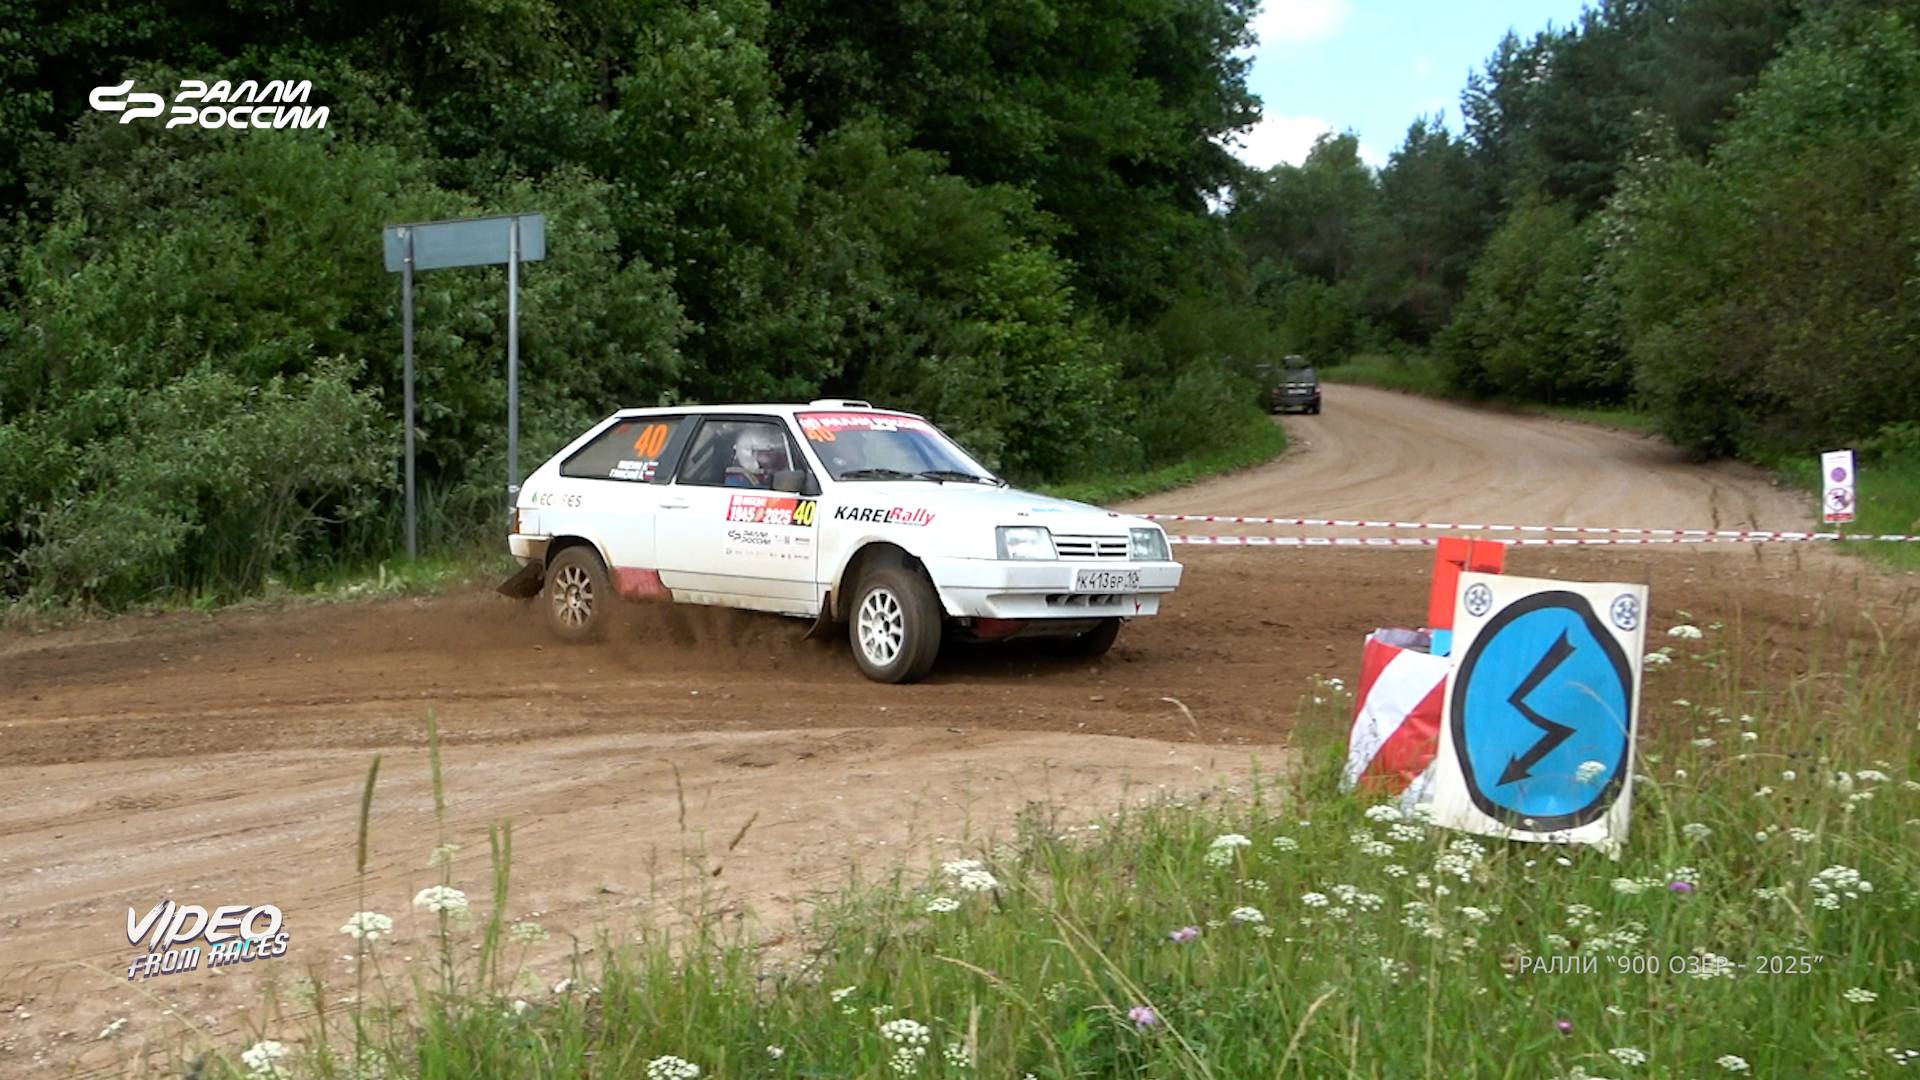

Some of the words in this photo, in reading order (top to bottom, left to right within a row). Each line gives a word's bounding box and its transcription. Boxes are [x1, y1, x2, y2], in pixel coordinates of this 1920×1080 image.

[634, 424, 668, 458] 40
[806, 428, 837, 442] 40
[730, 507, 757, 522] 1945
[763, 508, 793, 524] 2025
[793, 501, 817, 526] 40
